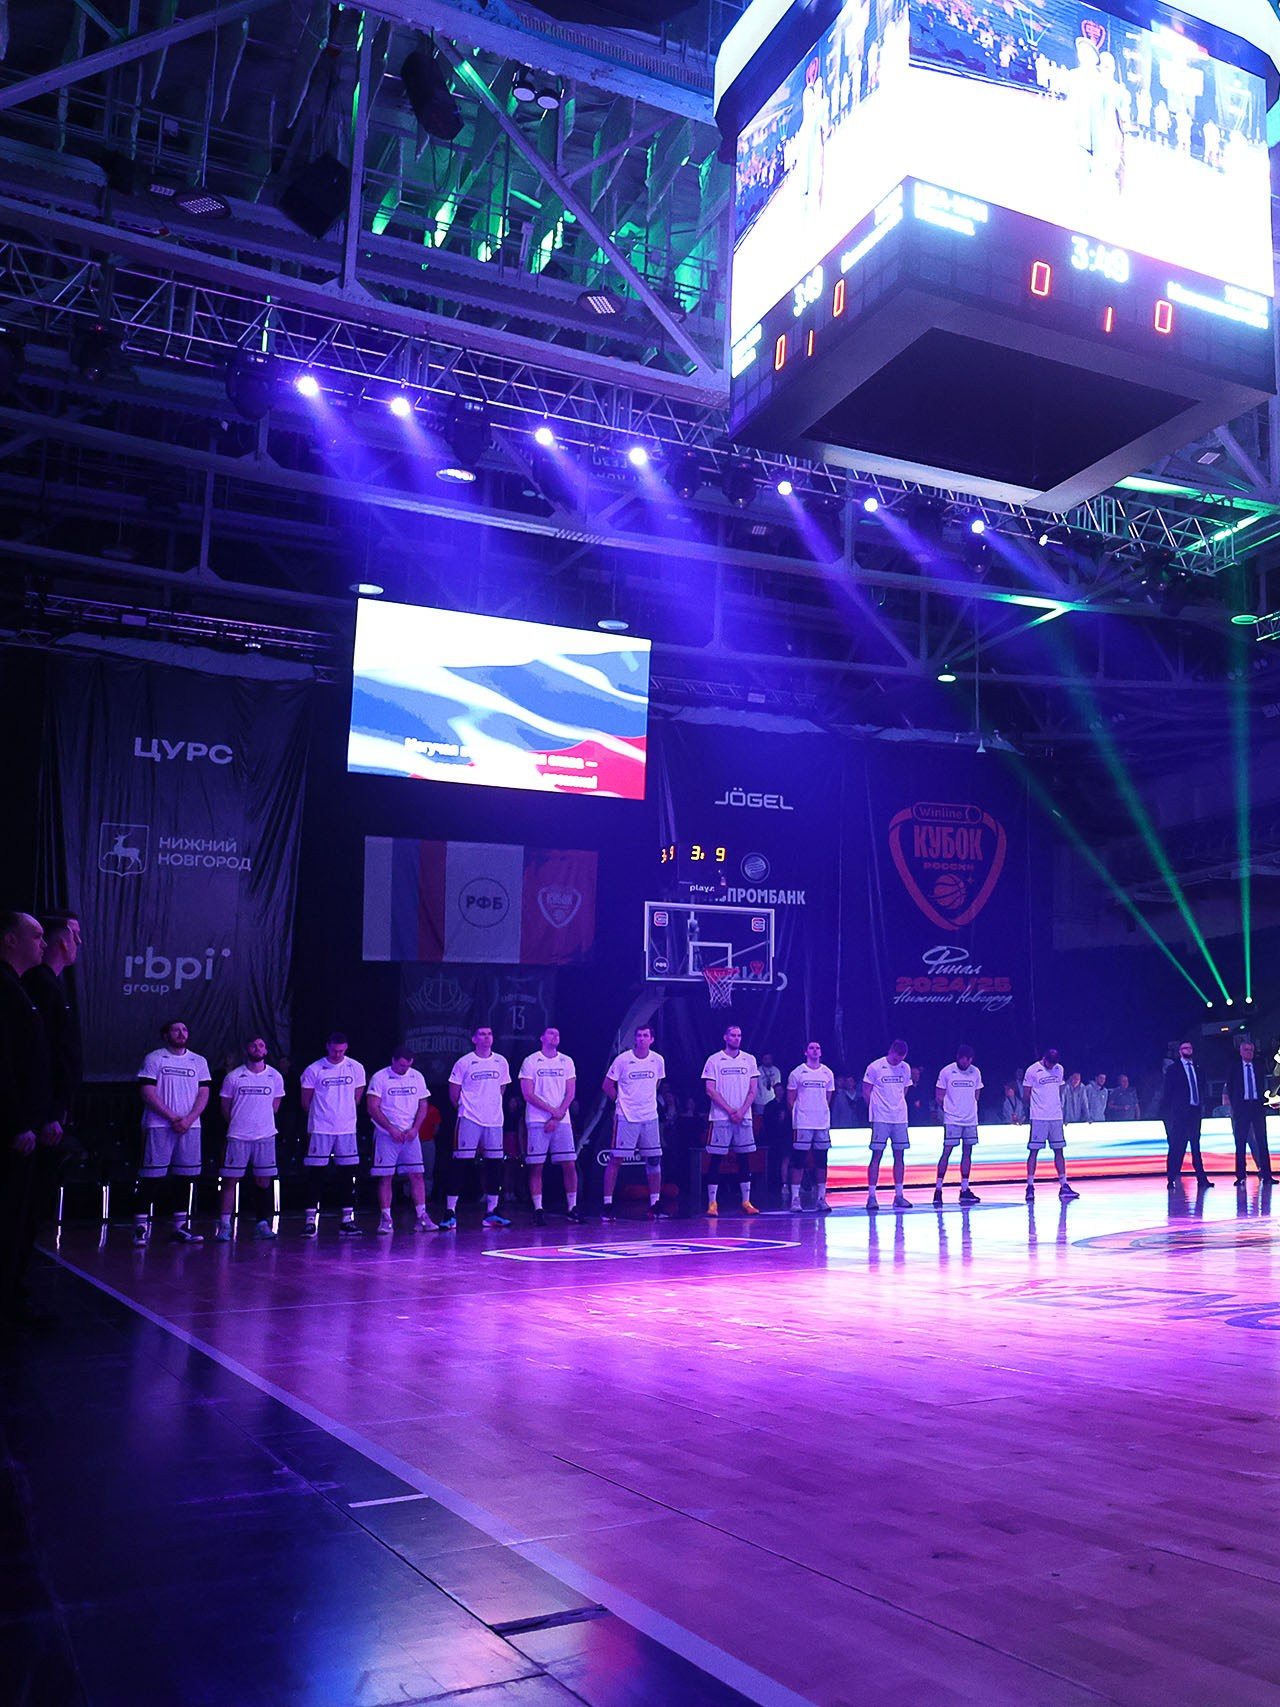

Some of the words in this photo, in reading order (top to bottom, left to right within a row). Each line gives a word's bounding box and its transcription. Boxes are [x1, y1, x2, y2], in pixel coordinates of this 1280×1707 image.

[1031, 259, 1051, 296] 0
[832, 278, 845, 318] 0
[1154, 299, 1173, 334] 0
[774, 333, 786, 371] 0
[133, 736, 233, 765] ЦУРС
[715, 787, 794, 810] JÖGEL
[158, 836, 238, 853] НИЖНИЙ
[913, 825, 984, 861] КУБОК
[157, 853, 251, 872] НОВГОРОД
[466, 895, 503, 910] РФБ
[714, 887, 806, 905] ПРОМБАНК
[922, 945, 982, 975] Финал
[123, 982, 170, 996] group
[895, 976, 1012, 993] 2024/25
